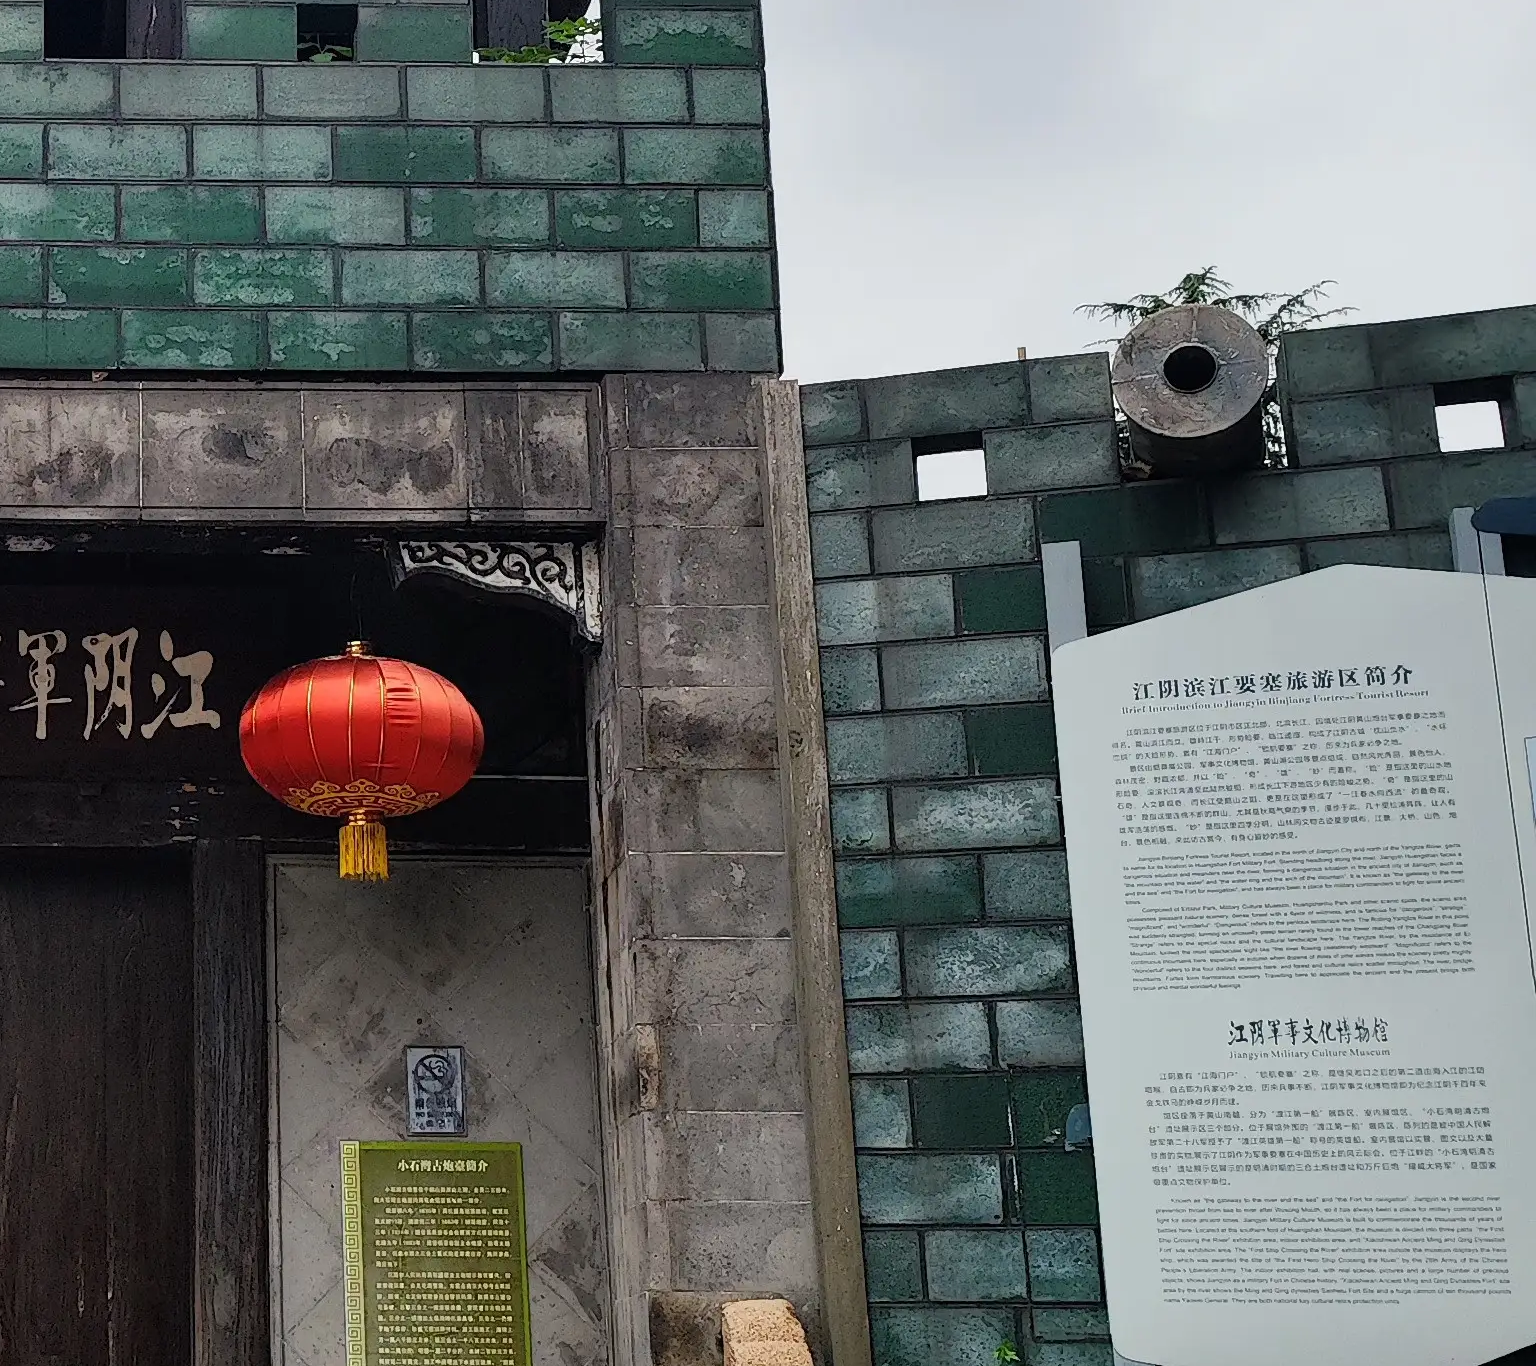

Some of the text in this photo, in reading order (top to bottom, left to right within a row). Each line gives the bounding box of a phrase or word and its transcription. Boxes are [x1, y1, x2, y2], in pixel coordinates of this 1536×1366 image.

[1132, 664, 1413, 701] 江阴滨江要塞旅游区简介
[1228, 1047, 1391, 1062] Jiangyin Military Culture Museum
